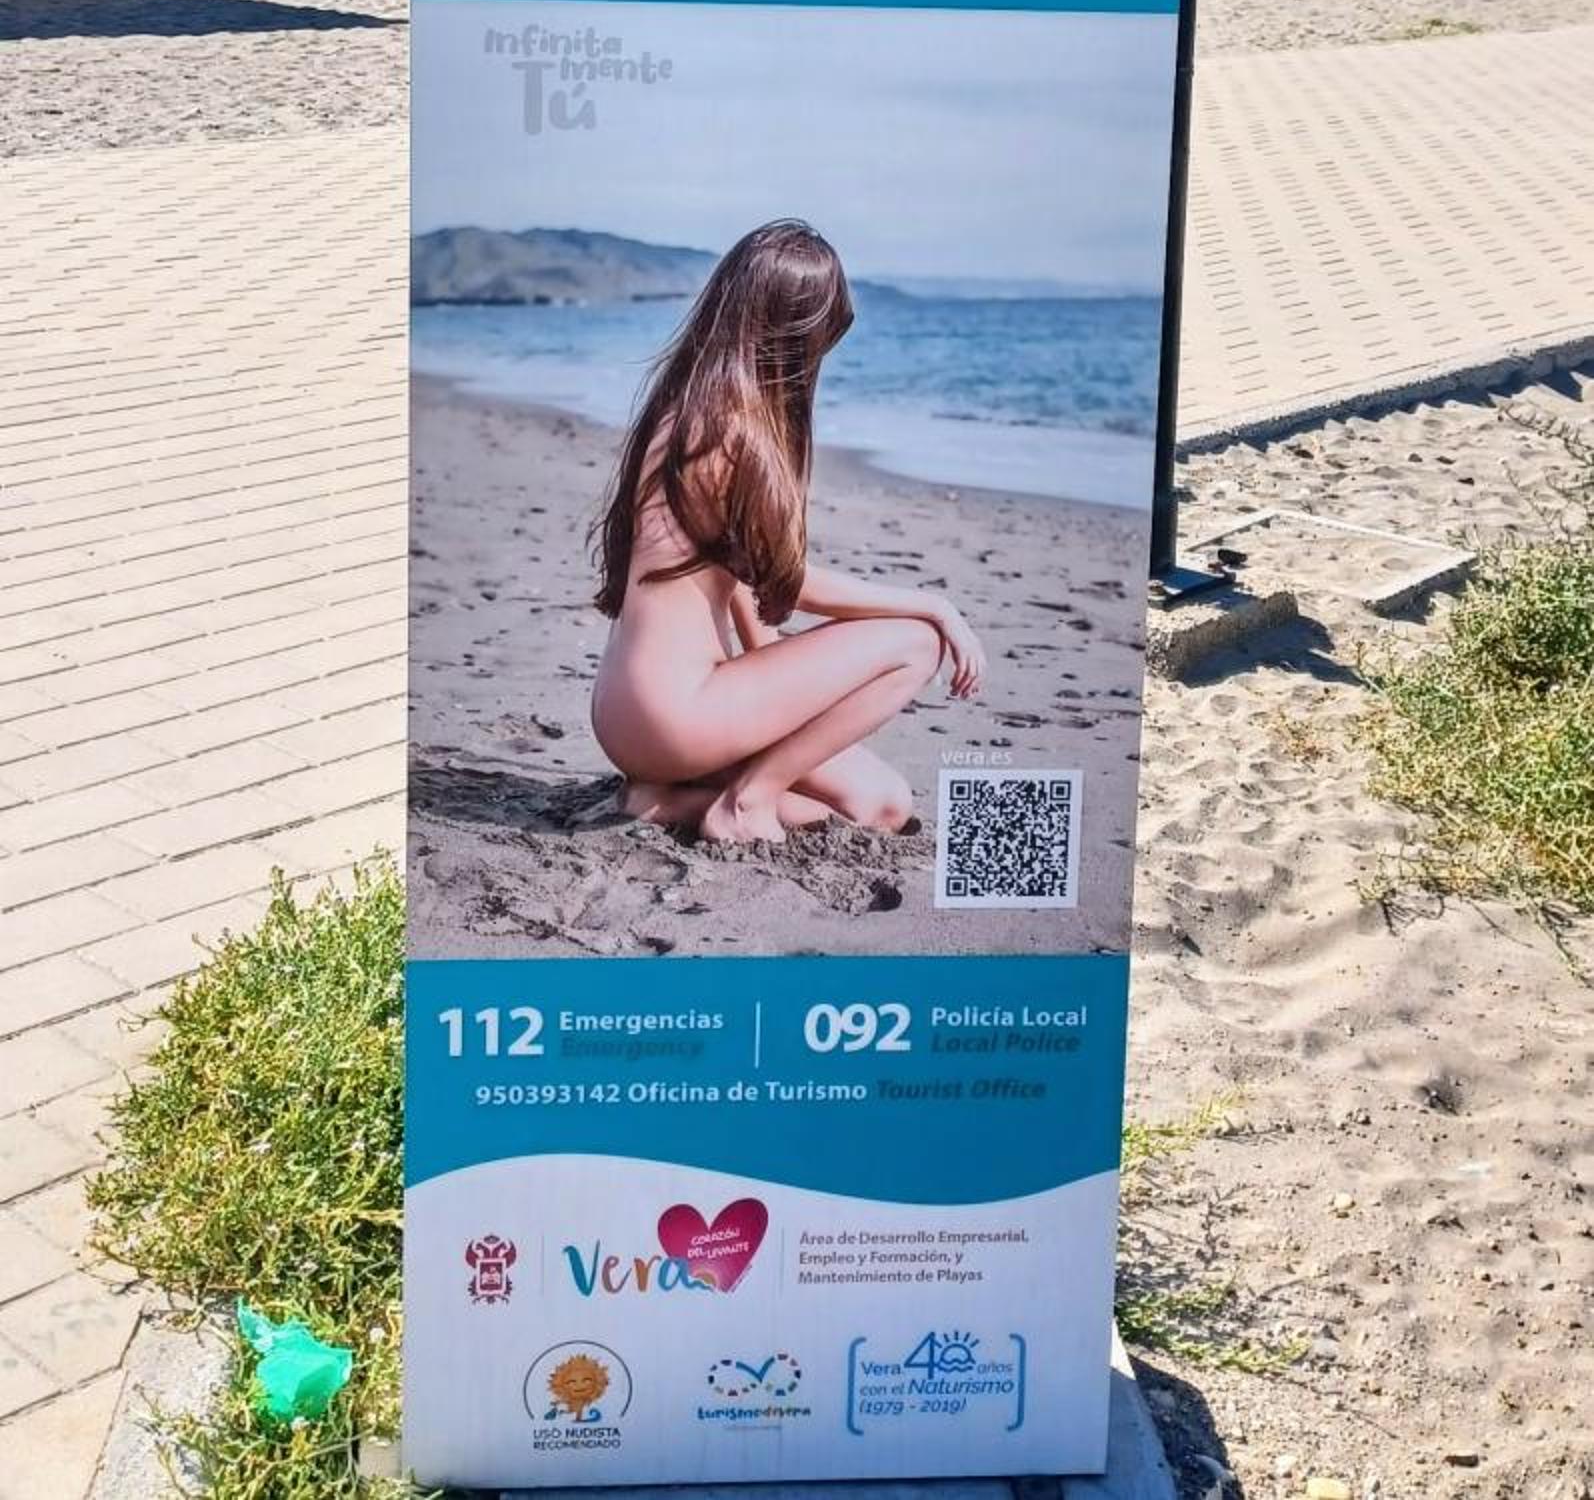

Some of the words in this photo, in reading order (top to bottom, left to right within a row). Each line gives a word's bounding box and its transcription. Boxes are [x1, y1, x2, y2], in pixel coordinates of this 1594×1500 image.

[941, 750, 1013, 766] vera.es
[439, 1007, 544, 1056] 112
[560, 1010, 723, 1034] Emergencias
[804, 1004, 910, 1052] 092
[932, 1007, 1013, 1026] Policía
[1023, 1006, 1086, 1026] Local
[932, 1031, 998, 1053] Local
[1006, 1031, 1080, 1052] Police
[476, 1084, 620, 1104] 950393142
[628, 1082, 719, 1102] Oficina
[728, 1081, 758, 1100] de
[765, 1081, 866, 1100] Turismo
[878, 1076, 963, 1100] Tourist
[971, 1078, 1046, 1098] Office
[800, 1229, 834, 1246] Área
[838, 1230, 856, 1245] de
[859, 1230, 935, 1245] Desarrollo
[938, 1229, 1029, 1246] Empresarial,
[799, 1251, 854, 1268] Empleo
[870, 1249, 951, 1266] Formación,
[563, 1240, 708, 1297] Vera
[798, 1269, 911, 1284] Mantenimiento
[915, 1269, 933, 1283] de
[937, 1268, 983, 1286] Playas
[861, 1361, 900, 1376] Vera
[860, 1383, 888, 1396] con
[891, 1380, 902, 1395] el
[908, 1379, 1014, 1395] Naturismo
[533, 1428, 561, 1439] USO
[565, 1427, 621, 1438] NUDISTA
[533, 1439, 621, 1450] RECOMENDADO
